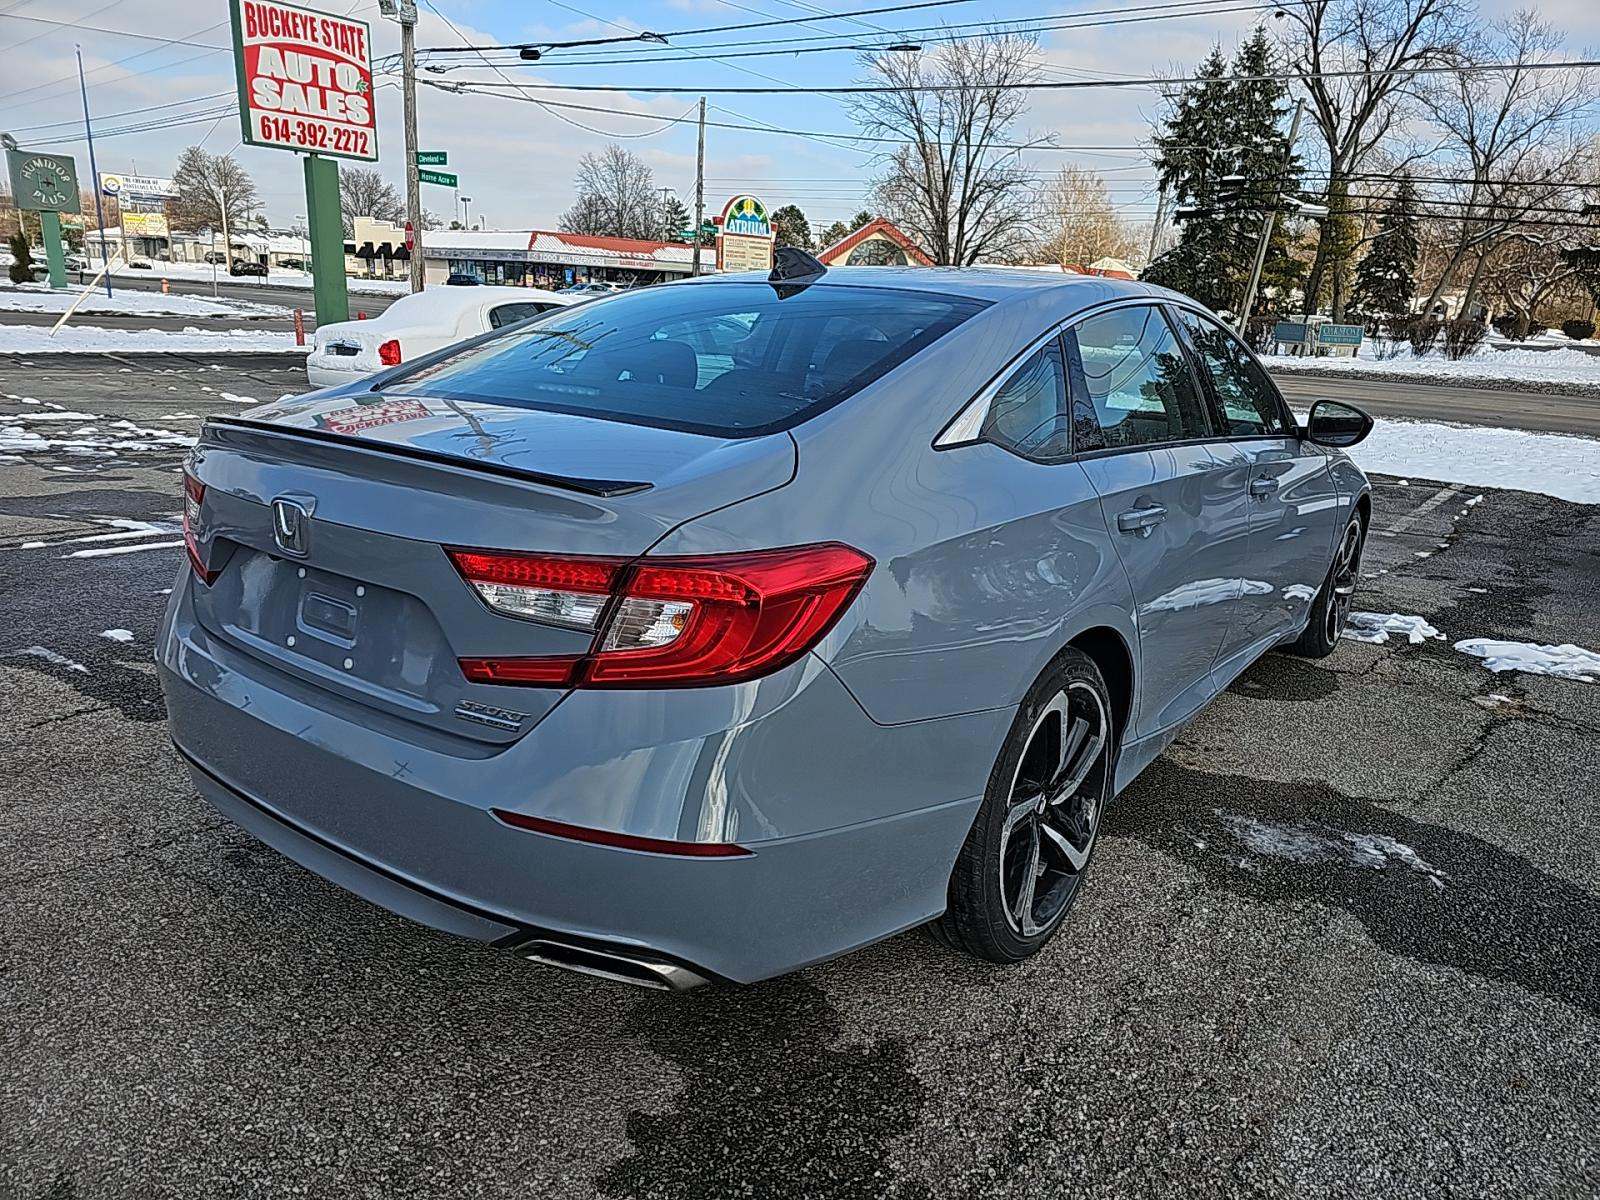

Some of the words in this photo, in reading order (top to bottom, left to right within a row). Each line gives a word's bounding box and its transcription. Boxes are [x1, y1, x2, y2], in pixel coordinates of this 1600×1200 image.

[244, 2, 318, 43] BUCKEYE
[321, 19, 366, 62] STATE
[256, 46, 361, 94] AUTO
[252, 77, 370, 125] SALES
[260, 115, 369, 155] 614-392-2272
[22, 158, 71, 182] HUMIDOR
[32, 190, 66, 205] PLUS
[729, 219, 766, 234] ATRIUM
[456, 699, 532, 721] SPORT
